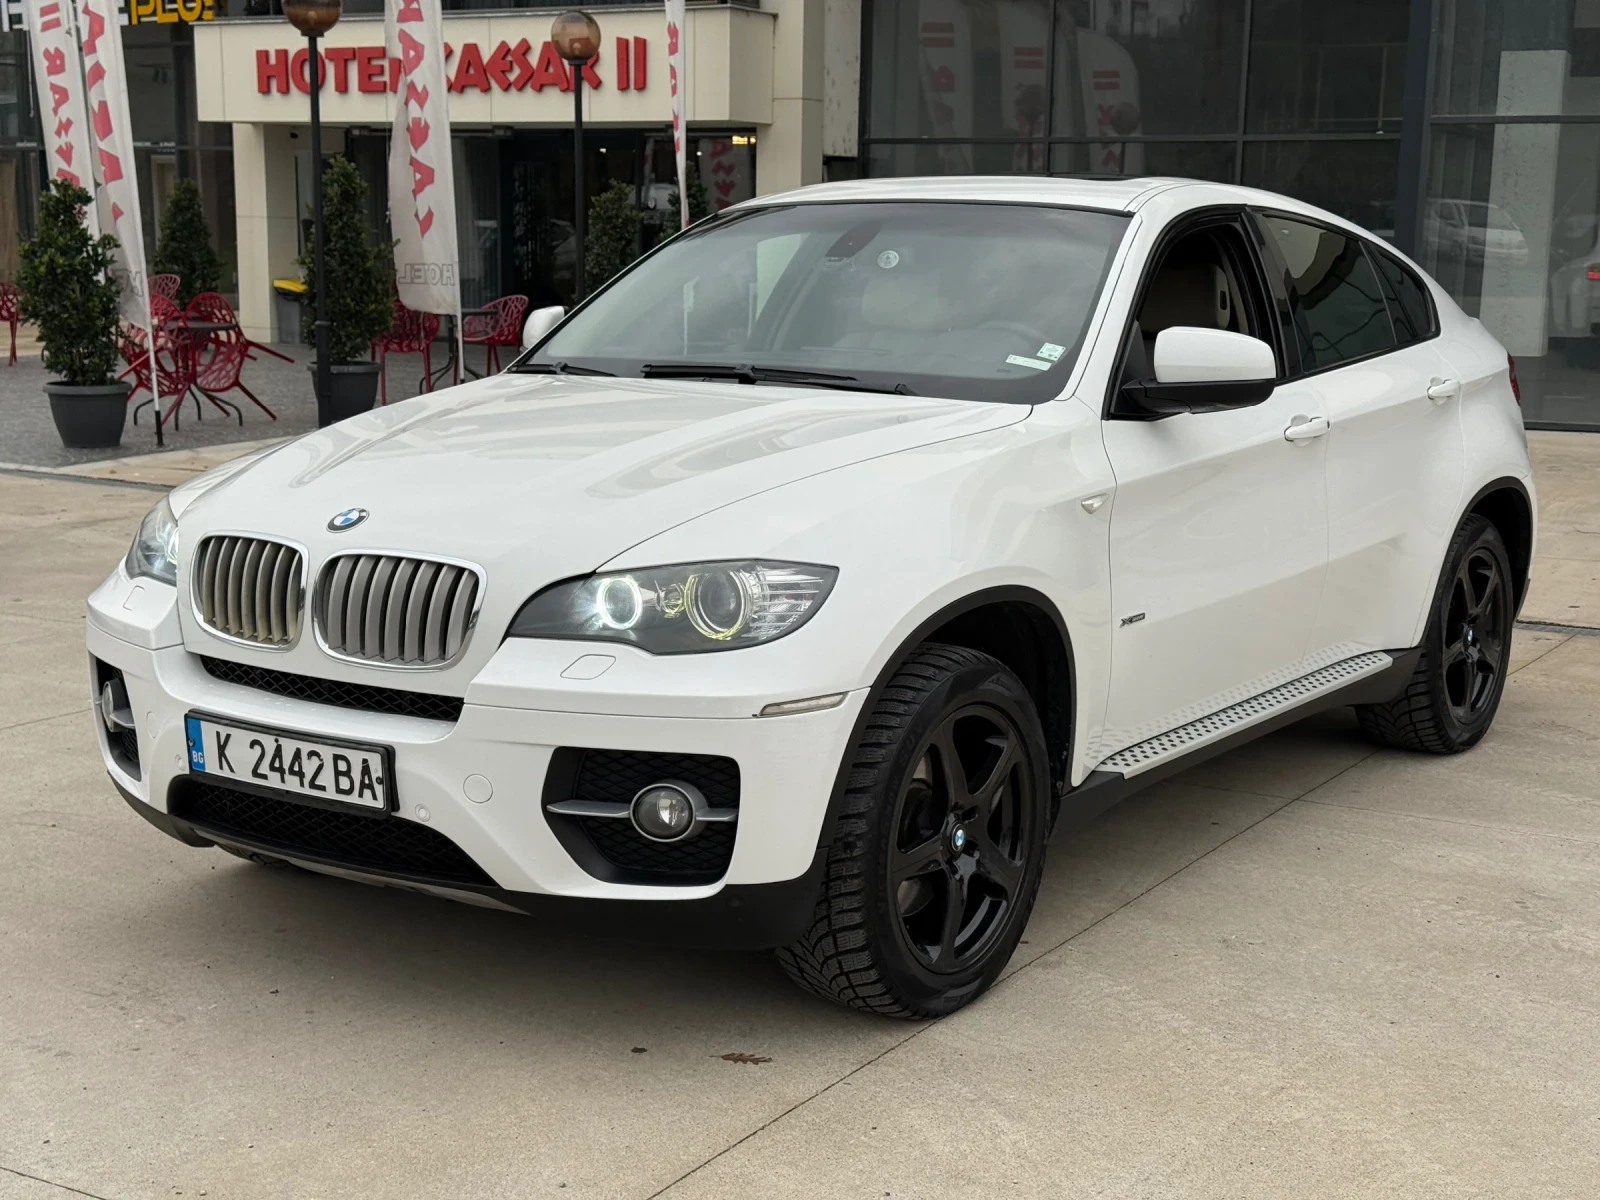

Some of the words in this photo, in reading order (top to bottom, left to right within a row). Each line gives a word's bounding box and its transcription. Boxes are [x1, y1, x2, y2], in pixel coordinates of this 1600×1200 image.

[616, 36, 647, 90] II
[192, 750, 204, 764] BG
[216, 731, 236, 774] K
[249, 738, 327, 793] 2442
[332, 753, 378, 801] BA
